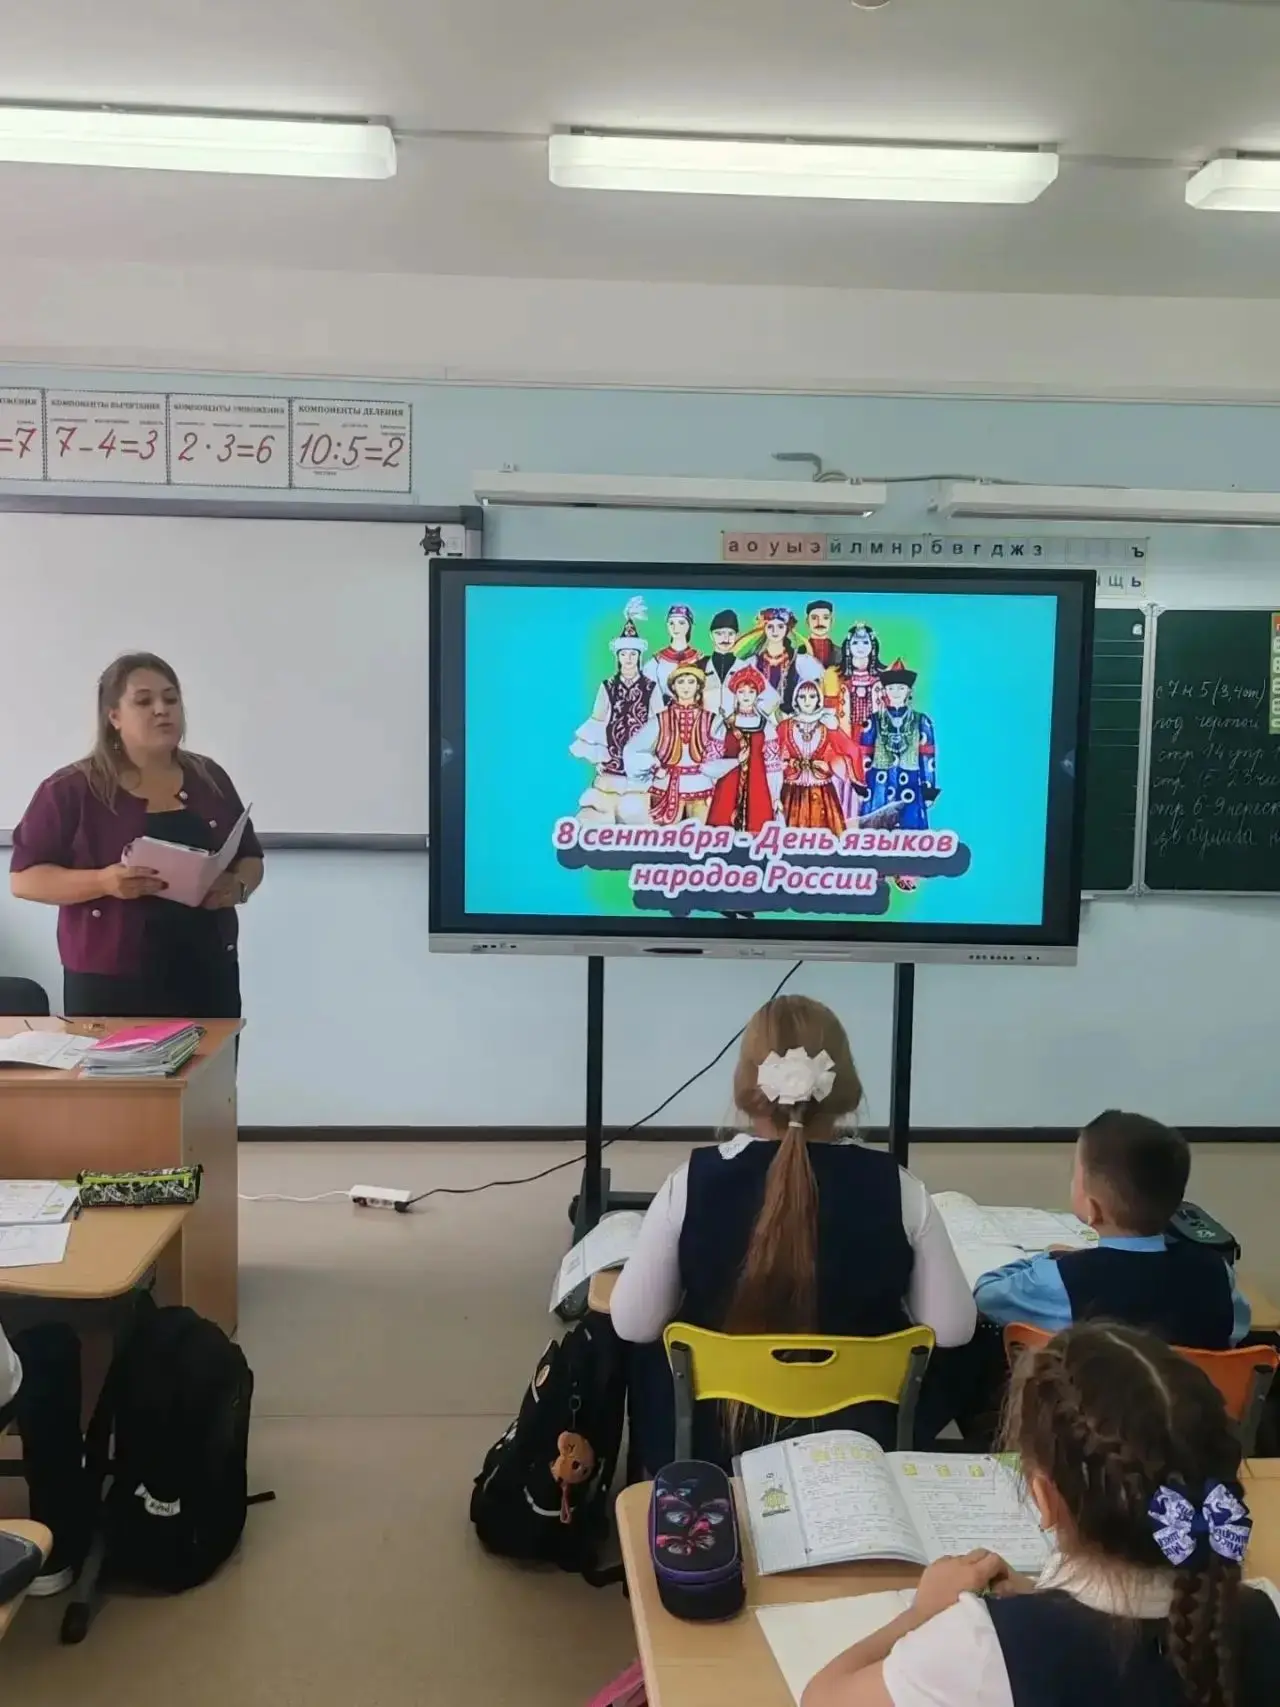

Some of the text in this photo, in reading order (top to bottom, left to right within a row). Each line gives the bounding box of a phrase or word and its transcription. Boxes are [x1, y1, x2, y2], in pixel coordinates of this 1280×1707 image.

[298, 405, 404, 417] КОМПОНЕНТЫ ДЕЛЕНИЯ
[556, 821, 576, 845] 8
[583, 823, 730, 855] сентября
[754, 826, 835, 856] День
[842, 834, 954, 853] языков
[633, 862, 873, 893] народов России
